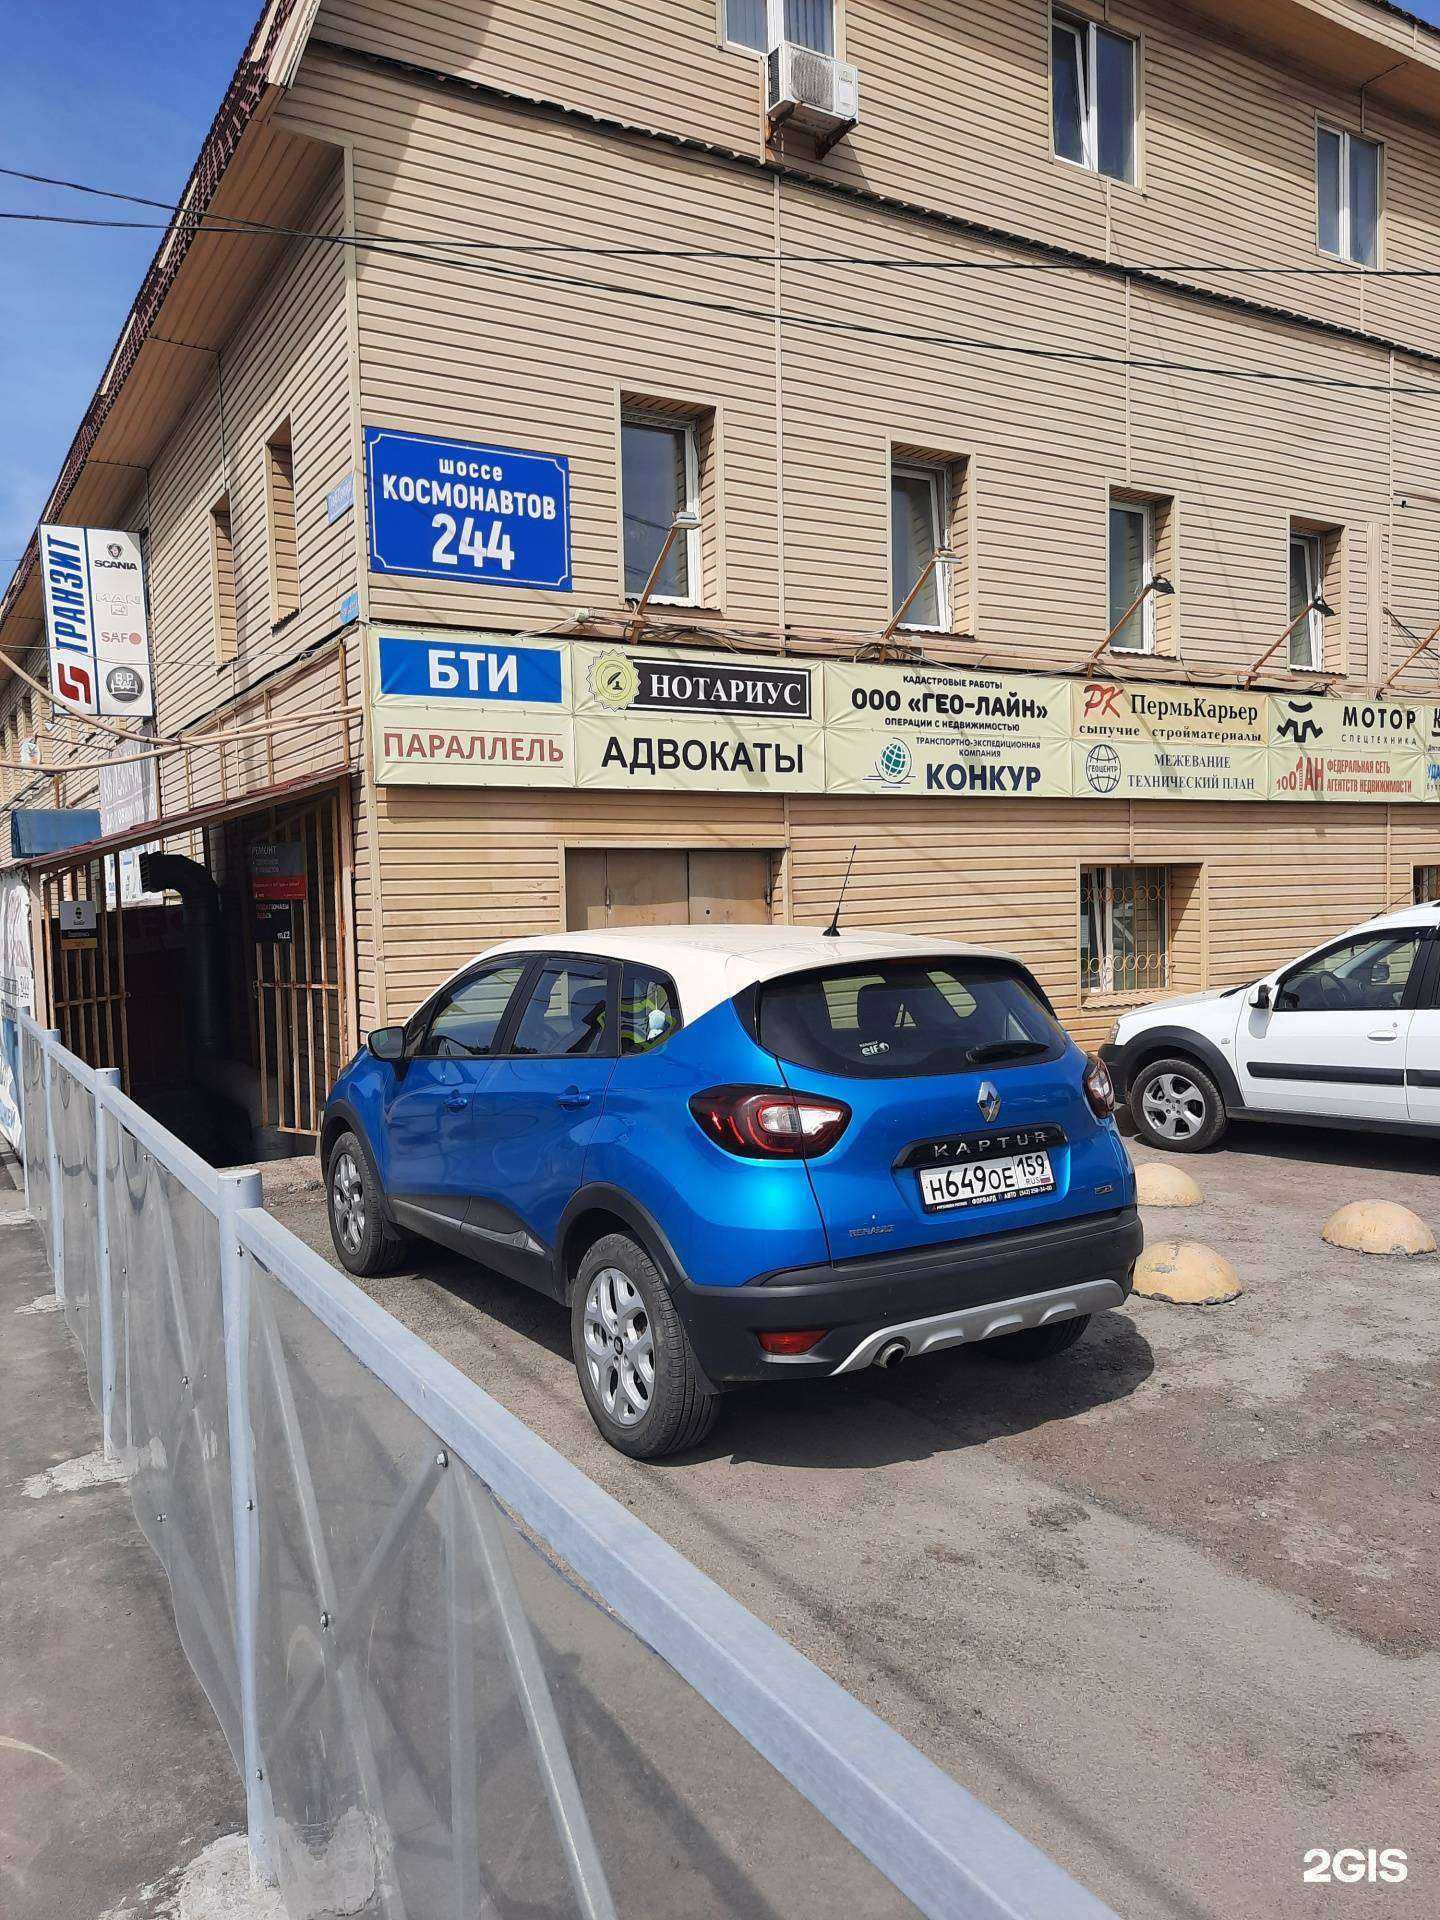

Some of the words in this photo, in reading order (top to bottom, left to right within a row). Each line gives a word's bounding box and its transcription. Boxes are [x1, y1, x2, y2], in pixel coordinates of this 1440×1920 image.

[439, 458, 503, 482] шоссе
[382, 473, 556, 520] КОСМОНАВТОВ
[431, 513, 515, 571] 244
[94, 560, 138, 571] SCANIA
[47, 534, 89, 653] ТРАНЗИТ
[428, 649, 518, 693] БТИ
[902, 675, 967, 688] КАДАСТРОВЫЕ
[968, 679, 1003, 690] РАБОТЫ
[649, 673, 801, 706] НОТАРИУС
[851, 687, 901, 711] ООО
[907, 691, 1049, 719] «ГЕО-ЛАЙН»
[1130, 693, 1258, 725] ПермьКарьер
[884, 717, 933, 729] ОПЕРАЦИИ
[934, 719, 940, 728] С
[942, 720, 1020, 732] НЕДВИЖИМОСТЬЮ
[1342, 706, 1416, 730] МОТОР
[916, 736, 1041, 750] ТРАНСПОРТНО-ЭКСПЕДИЦИОННАЯ
[1079, 724, 1140, 738] сыпучие
[1151, 726, 1262, 743] стройматериалы
[1341, 734, 1417, 746] СПЕЦТЕХНИКА
[384, 732, 564, 762] ПАРАЛЛЕЛЬ
[601, 736, 804, 775] АДВОКАТЫ
[958, 749, 1001, 758] КОМПАНИЯ
[1154, 753, 1231, 769] МЕЖЕВАНИЕ
[1327, 759, 1374, 775] ФЕДЕРАЛЬНАЯ
[1375, 761, 1391, 774] СЕТЬ
[926, 763, 1042, 792] КОНКУР
[1127, 774, 1220, 790] ТЕХНИЧЕСКИЙ
[1222, 777, 1255, 790] ПЛАН
[1327, 778, 1358, 793] АГЕНТСТВ
[1359, 779, 1412, 795] НЕДВИЖИМОСТИ
[934, 1131, 1048, 1157] KAPTUR
[1016, 1154, 1046, 1178] 159
[1025, 1177, 1041, 1187] RUS
